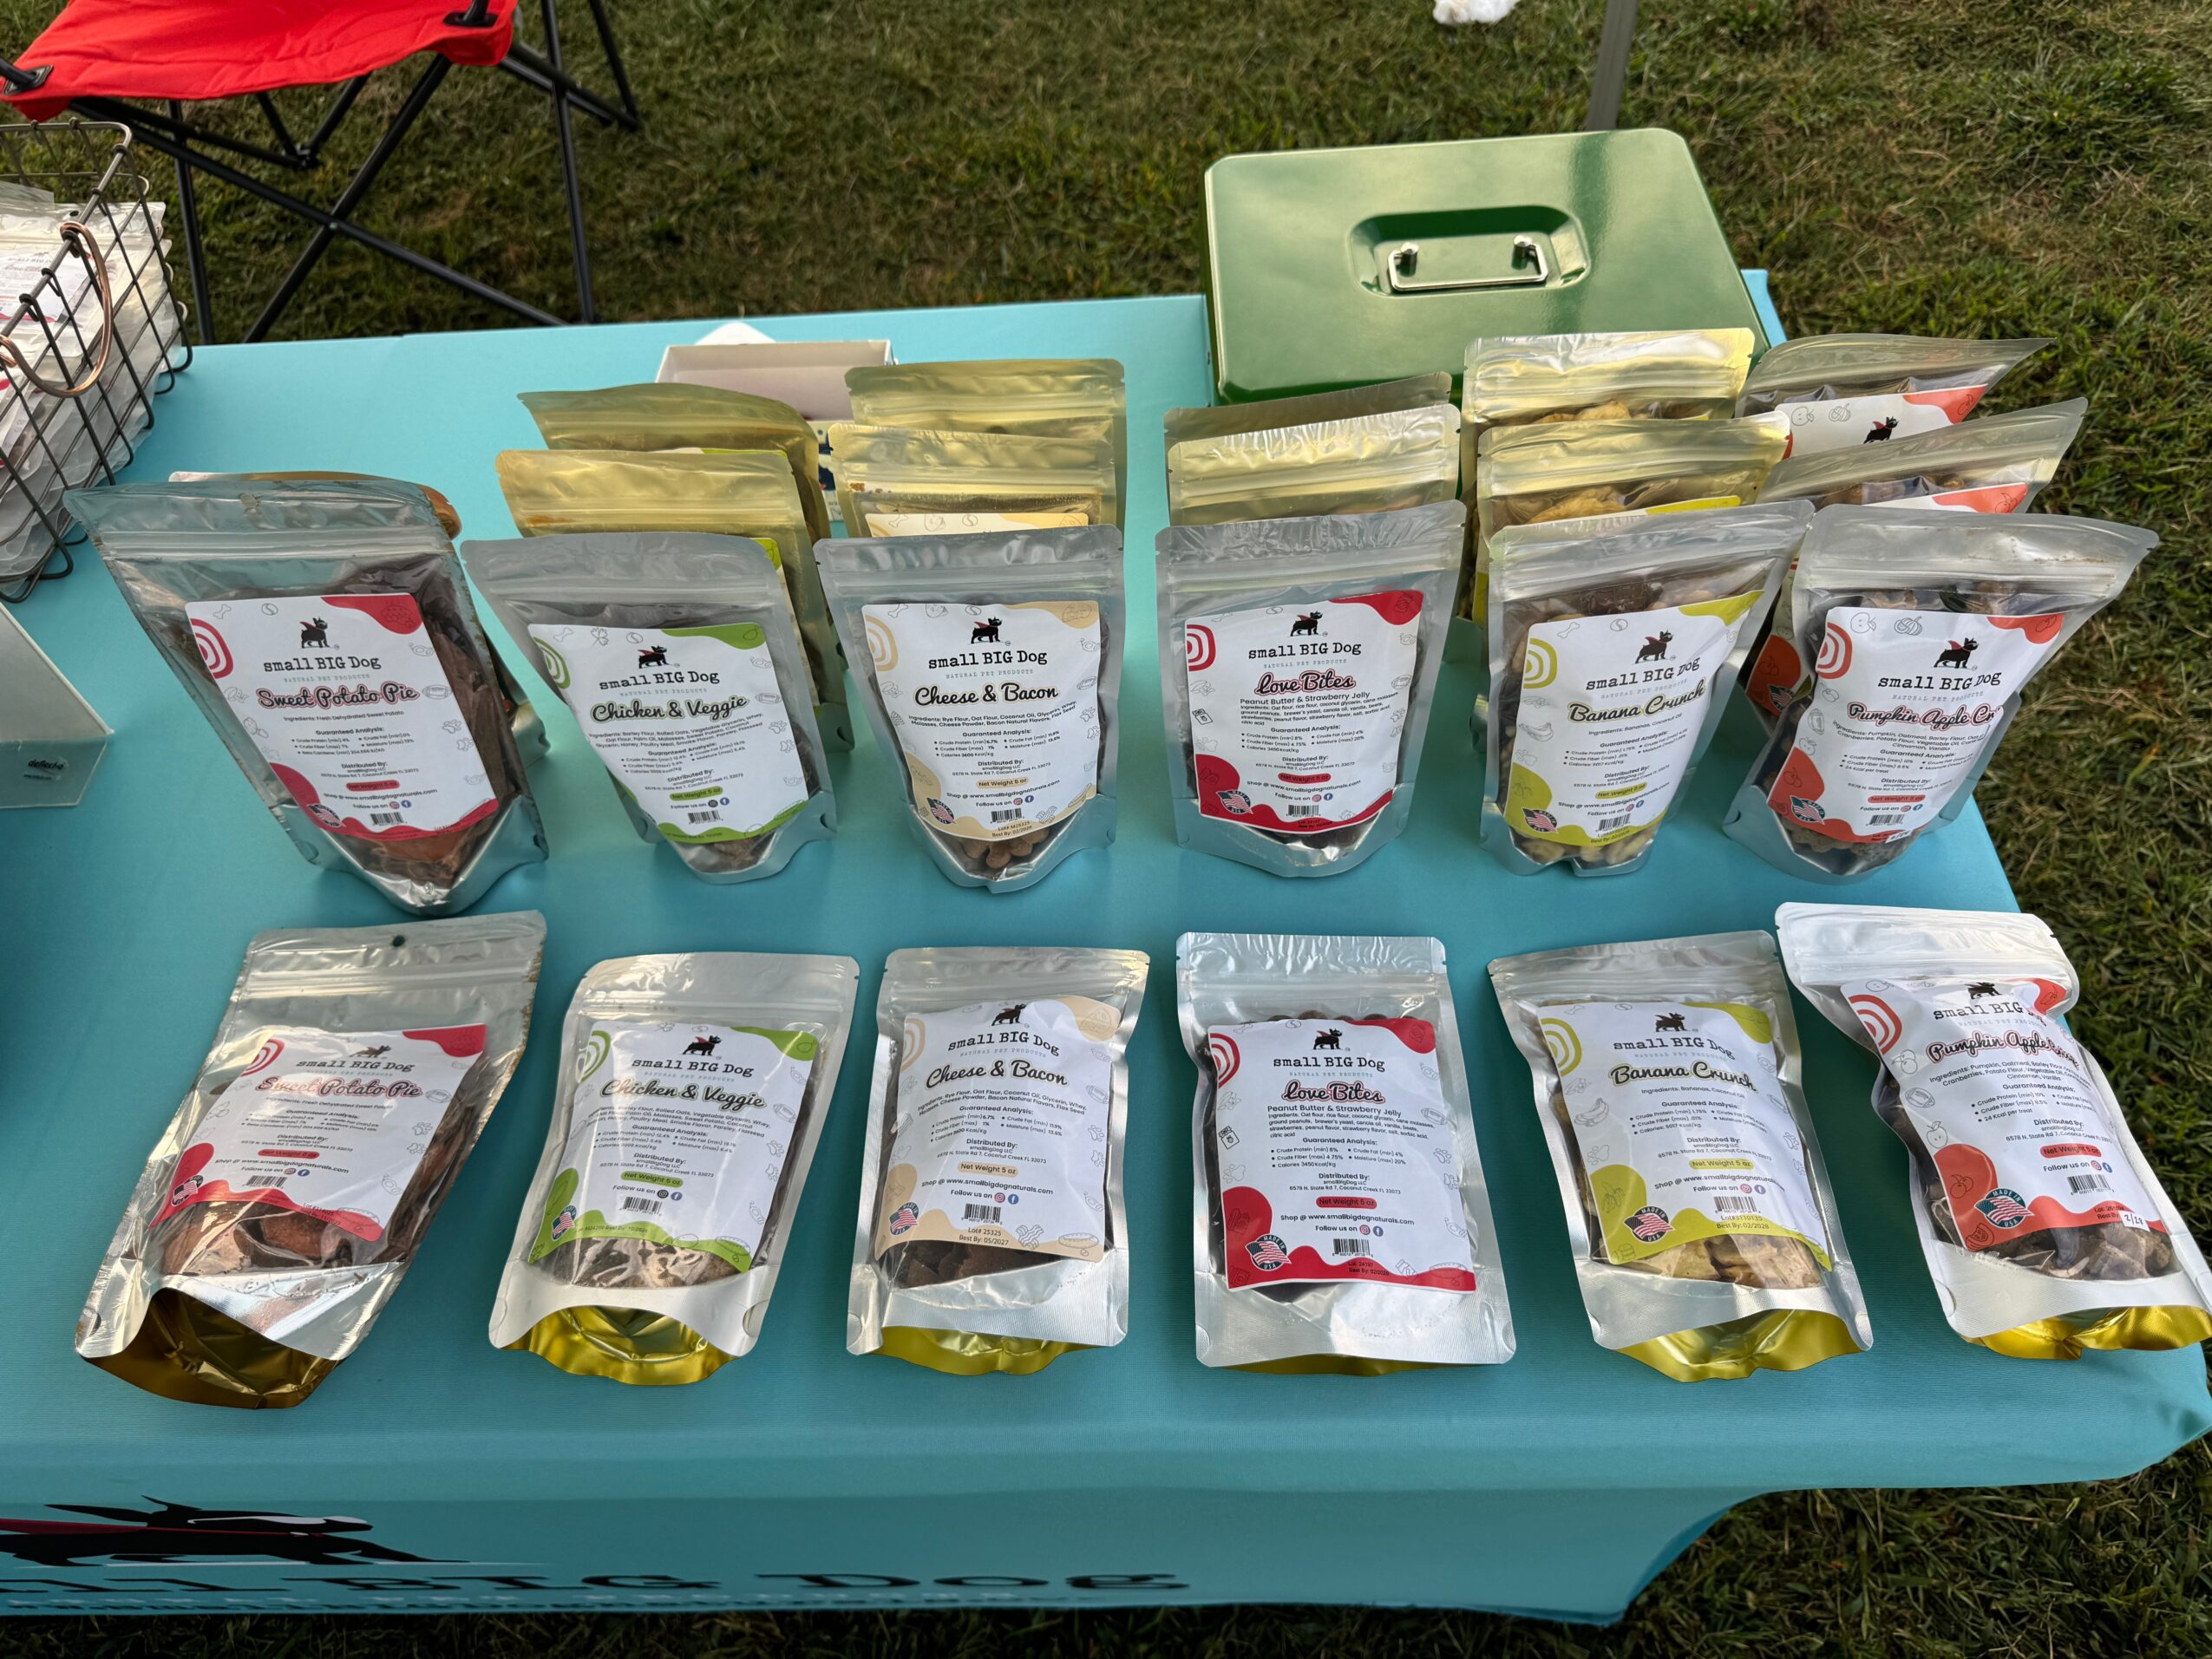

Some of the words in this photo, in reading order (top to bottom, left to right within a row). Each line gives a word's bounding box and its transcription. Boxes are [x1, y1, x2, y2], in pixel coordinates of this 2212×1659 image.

[929, 654, 978, 669] small
[982, 651, 1013, 664] BIG
[1018, 650, 1047, 665] Dog
[1248, 645, 1295, 659] small
[1299, 643, 1329, 656] BIG
[1332, 642, 1361, 655] Dog
[264, 658, 313, 671] small
[315, 657, 345, 670] BIG
[348, 656, 382, 670] Dog
[599, 675, 651, 690] small
[653, 672, 685, 683] BIG
[688, 671, 720, 683] Dog
[1304, 671, 1354, 690] Bites
[1586, 673, 1638, 690] small
[1642, 668, 1674, 683] BIG
[1677, 657, 1700, 676] Dog
[1878, 676, 1934, 689] small
[1940, 677, 1972, 690] BIG
[1974, 673, 2001, 687] Dog
[258, 689, 314, 708] Sweet
[316, 686, 379, 708] Potato
[383, 683, 417, 703] Pie
[915, 686, 978, 706] Cheese
[983, 685, 997, 702] &
[1001, 683, 1058, 701] Bacon
[1306, 694, 1349, 702] Strawberry
[1351, 691, 1370, 701] Jelly
[1569, 703, 1640, 722] Banana
[1646, 678, 1706, 715] Crunch
[592, 700, 664, 722] Chicken
[668, 703, 683, 717] &
[687, 696, 748, 722] Veggie
[1849, 704, 1917, 725] Pumpkin
[1922, 705, 1970, 729] Apple
[1312, 724, 1340, 733] Analysis:
[1600, 737, 1639, 748] Guaranteed
[1934, 1005, 1989, 1020] small
[1991, 1002, 2023, 1014] BIG
[948, 1032, 995, 1051] small
[999, 1031, 1030, 1043] BIG
[1033, 1035, 1059, 1056] Dog
[1613, 1039, 1668, 1050] small
[1672, 1037, 1705, 1048] BIG
[1707, 1039, 1735, 1060] Dog
[1928, 1032, 2004, 1061] Pumpkin
[2006, 1031, 2049, 1054] Apple
[296, 1060, 346, 1068] small
[349, 1061, 379, 1069] BIG
[383, 1062, 416, 1072] Dog
[632, 1059, 684, 1070] small
[688, 1061, 719, 1073] BIG
[723, 1064, 754, 1077] Dog
[926, 1065, 987, 1088] Cheese
[991, 1061, 1005, 1076] &
[1011, 1059, 1067, 1086] Bacon
[1273, 1056, 1320, 1068] small
[1325, 1057, 1353, 1068] BIG
[1358, 1057, 1384, 1073] Dog
[1611, 1066, 1689, 1084] Banana
[1692, 1061, 1757, 1092] Crunch
[320, 1078, 385, 1098] Potato
[388, 1081, 422, 1097] Pie
[602, 1080, 677, 1097] Chicken
[682, 1084, 696, 1098] &
[705, 1087, 765, 1111] Veggie
[1329, 1082, 1384, 1102] Bites
[1003, 1107, 1034, 1115] Analysis:
[1336, 1106, 1381, 1115] Strawberry
[1384, 1108, 1401, 1118] Jelly
[632, 1124, 676, 1133] Guaranteed
[677, 1128, 709, 1137] Analysis:
[966, 1139, 1005, 1147] Distributed
[2059, 1146, 2085, 1154] Weight
[634, 1153, 673, 1163] Distributed
[2043, 1164, 2067, 1172] Follow
[638, 1173, 664, 1183] Weight
[946, 1179, 1053, 1195] www.smallbigdognaturals.com
[1308, 1214, 1415, 1225] www.smallbigdognaturals.com
